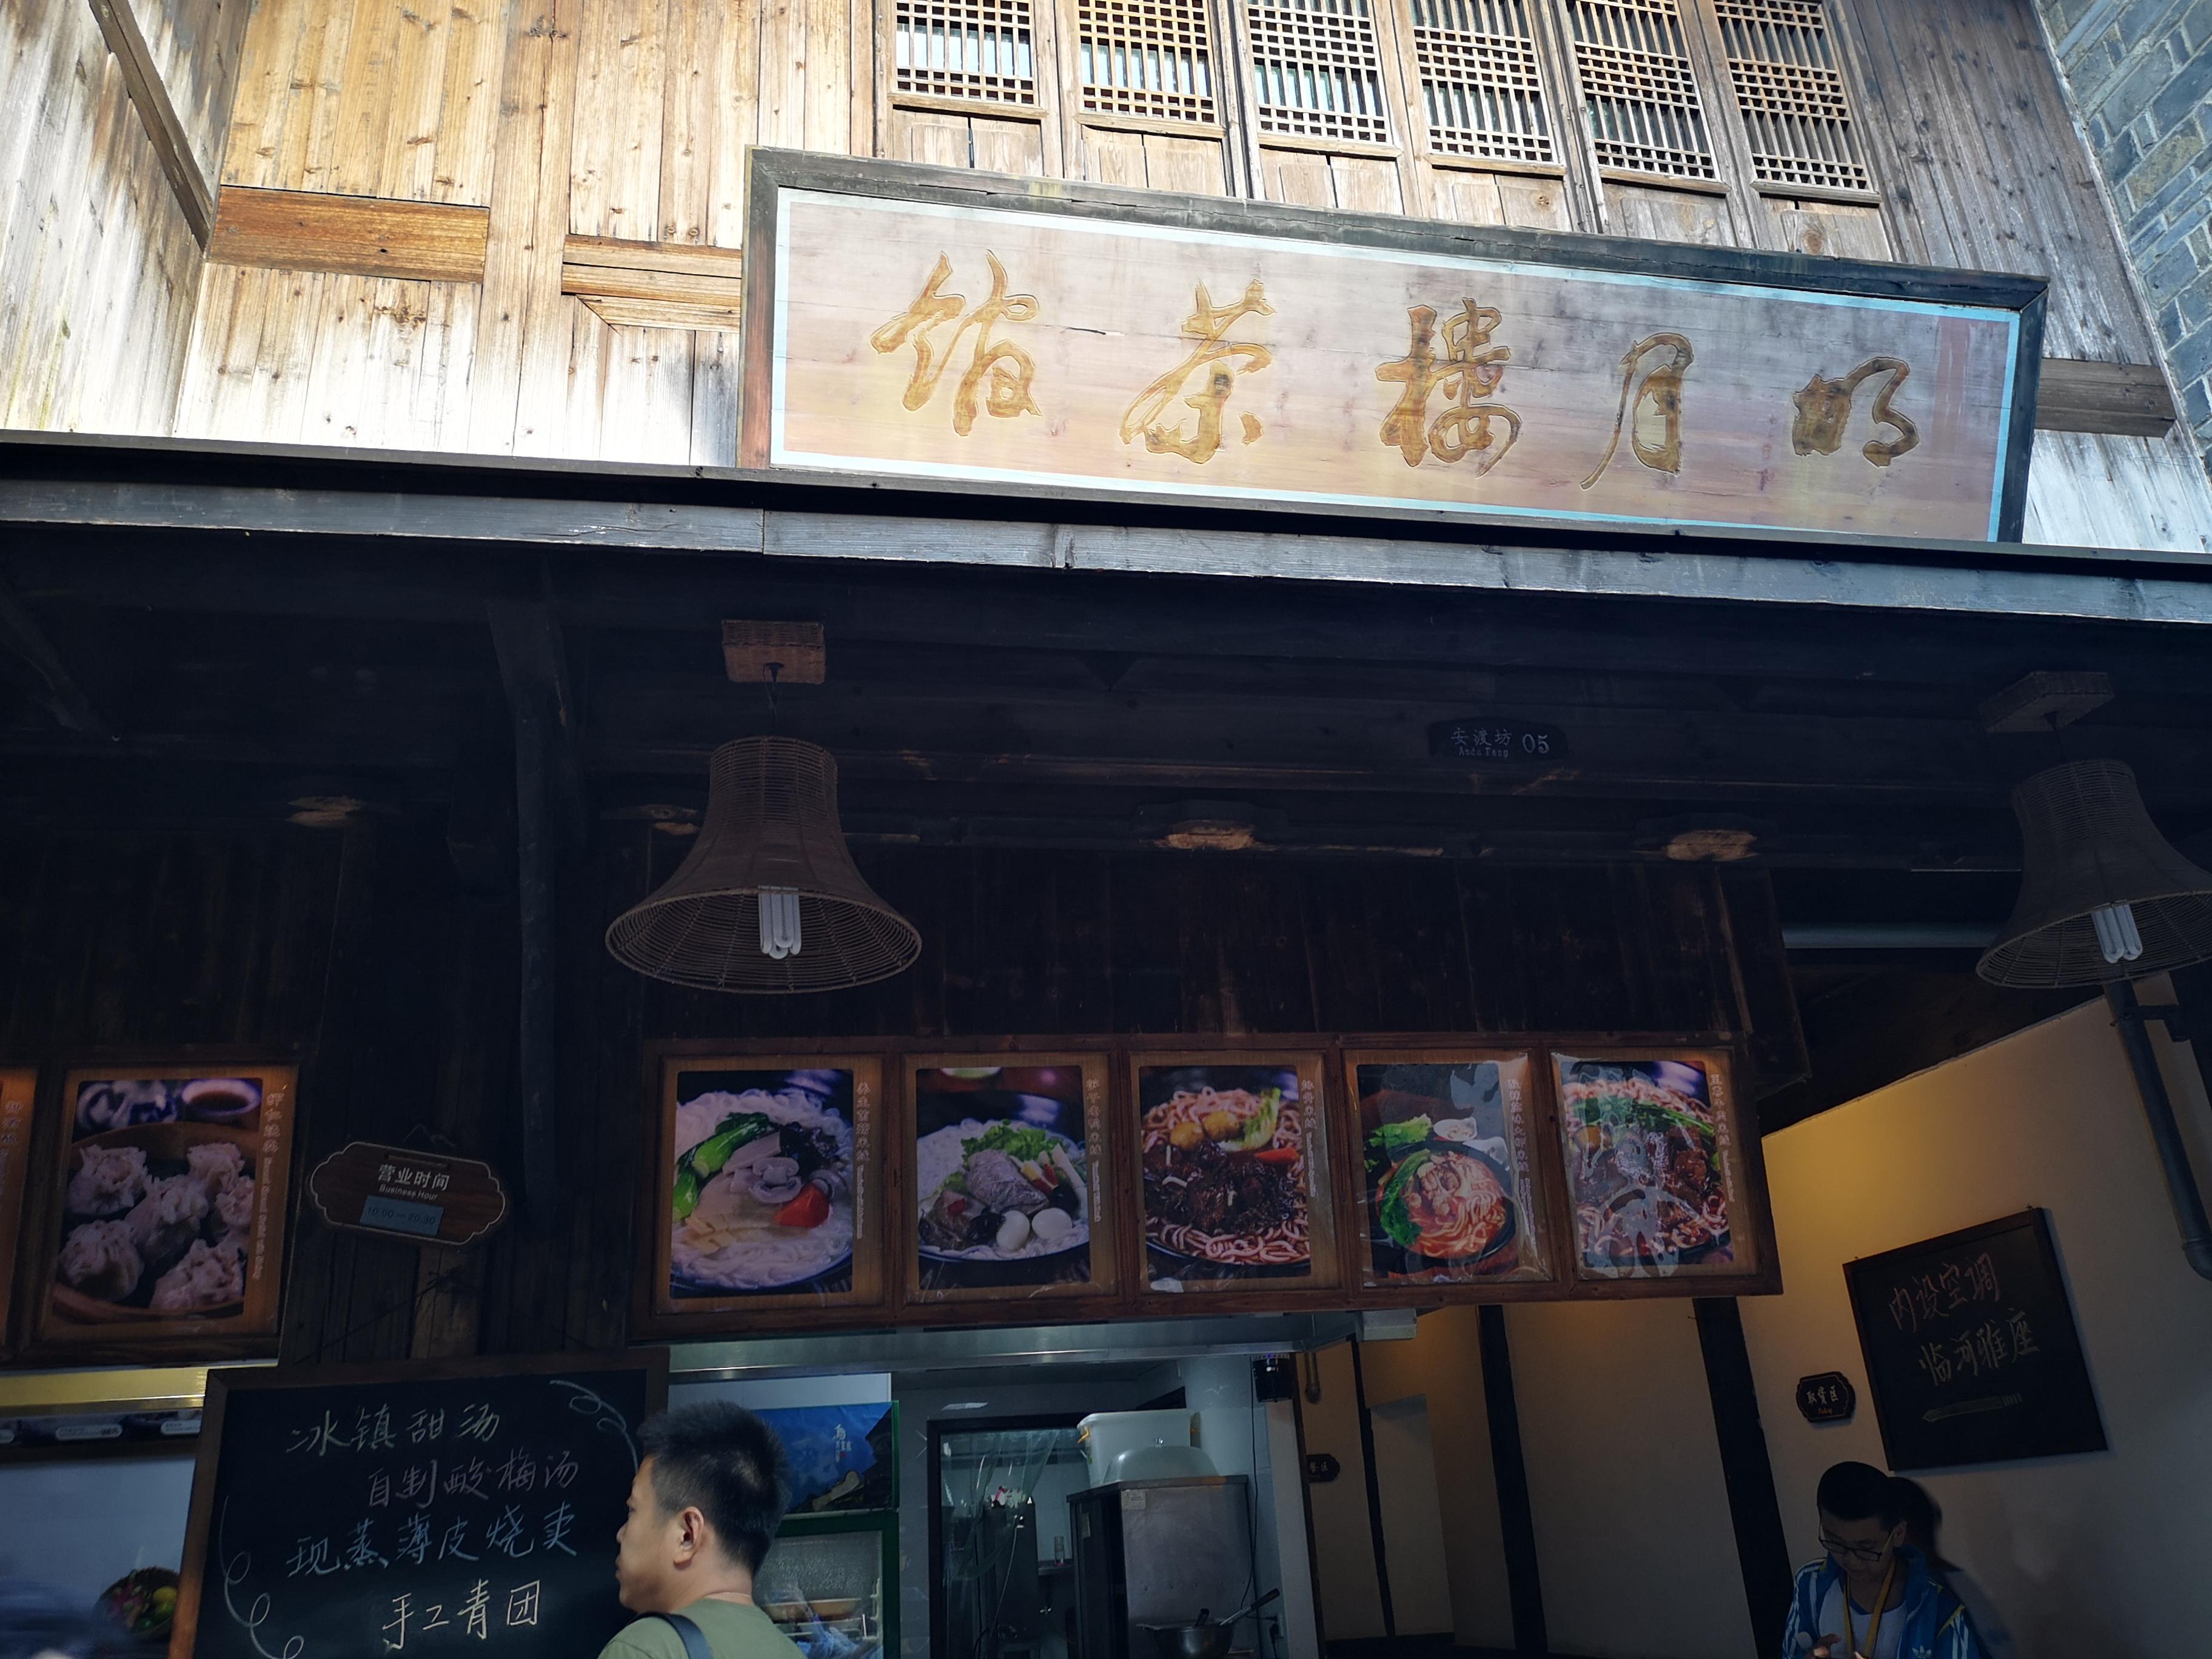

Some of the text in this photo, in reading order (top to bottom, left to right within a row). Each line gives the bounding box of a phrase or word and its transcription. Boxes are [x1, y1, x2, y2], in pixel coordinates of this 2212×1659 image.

[1522, 733, 1550, 754] 05
[378, 1163, 451, 1191] 营业时间
[378, 1183, 438, 1202] Business Hour
[1888, 1252, 2000, 1333] 内设空调
[1917, 1307, 2040, 1387] 临河雅座
[285, 1402, 501, 1457] 冰镇甜汤
[367, 1447, 580, 1509] 自制酸梅汤
[285, 1499, 578, 1578] 现蒸薄皮烧卖
[381, 1578, 542, 1650] 手工青团
